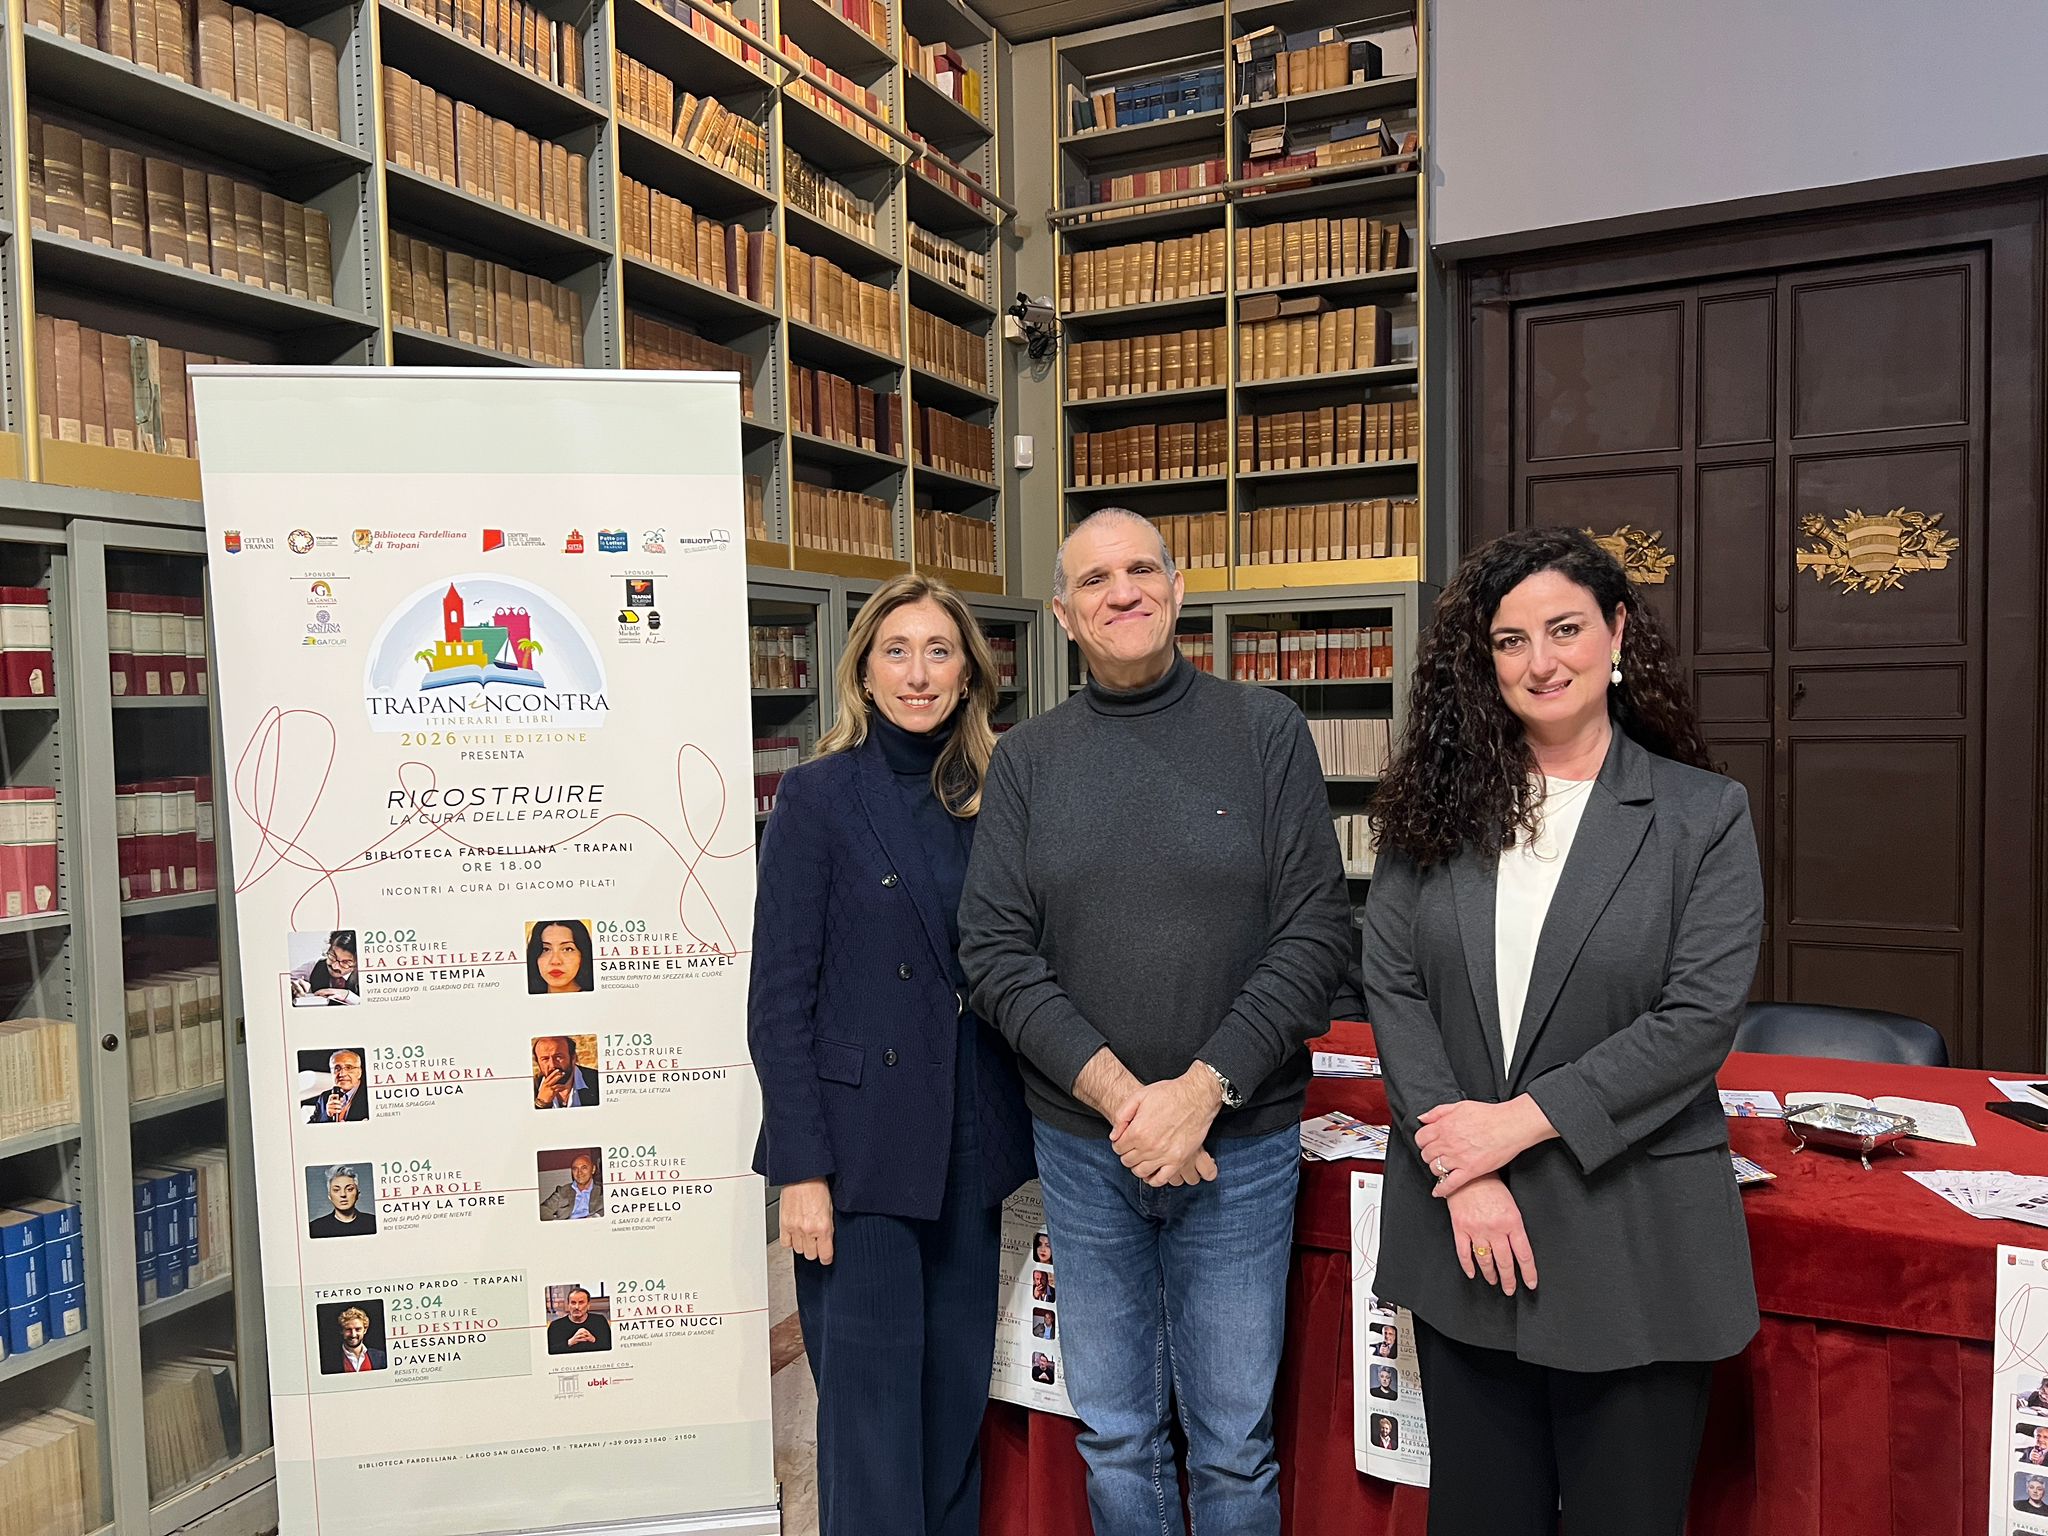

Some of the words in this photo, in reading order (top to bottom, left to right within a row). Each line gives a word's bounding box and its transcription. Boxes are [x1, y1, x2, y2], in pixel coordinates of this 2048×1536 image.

[374, 530, 416, 539] Biblioteca
[418, 530, 467, 538] Fardelliana
[374, 541, 382, 549] di
[387, 542, 420, 550] Trapani
[426, 716, 497, 726] ITINERARI
[505, 716, 512, 724] E
[518, 714, 553, 724] LIBRI
[400, 732, 457, 746] 2026
[463, 735, 495, 744] VIII
[504, 733, 587, 744] EDIZIONE
[461, 750, 525, 760] PRESENTA
[387, 784, 605, 808] RICOSTRUIRE
[390, 814, 412, 825] LA
[418, 812, 466, 824] CURA
[473, 810, 527, 822] DELLE
[532, 808, 600, 821] PAROLE
[365, 849, 452, 861] BIBLIOTECA
[459, 845, 557, 857] FARDELLIANA
[574, 842, 633, 852] TRAPANI
[462, 862, 492, 872] ORE
[500, 860, 542, 871] 18.00
[382, 885, 442, 896] INCONTRI
[447, 885, 455, 893] A
[460, 883, 492, 892] CURA
[498, 882, 510, 891] DI
[516, 880, 574, 890] GIACOMO
[580, 879, 616, 888] PILATI
[596, 920, 646, 933] 06.03
[364, 929, 416, 944] 20.02
[600, 932, 678, 942] RICOSTRUIRE
[364, 942, 448, 954] RICOSTRUIRE
[600, 946, 620, 956] LA
[630, 942, 721, 956] BELLEZZA
[366, 956, 387, 968] LA
[396, 950, 519, 966] GENTILEZZA
[600, 960, 660, 971] SABRINE
[666, 959, 682, 969] EL
[687, 956, 734, 968] MAYEL
[366, 970, 424, 984] SIMONE
[432, 968, 485, 981] TEMPIA
[702, 970, 723, 978] CUORE
[604, 1033, 653, 1047] 17.03
[373, 1045, 425, 1060] 13.03
[605, 1046, 683, 1057] RICOSTRUIRE
[373, 1057, 455, 1070] RICOSTRUIRE
[606, 1060, 625, 1070] LA
[635, 1059, 680, 1069] PACE
[374, 1074, 396, 1084] LA
[406, 1067, 495, 1082] MEMORIA
[606, 1073, 656, 1084] DAVIDE
[662, 1070, 726, 1082] RONDONI
[375, 1088, 420, 1100] LUCIO
[426, 1085, 464, 1096] LUCA
[406, 1100, 436, 1108] SPIAGGIA
[608, 1146, 657, 1160] 20.04
[380, 1159, 432, 1175] 10.04
[609, 1158, 687, 1169] RICOSTRUIRE
[381, 1171, 462, 1184] RICOSTRUIRE
[610, 1172, 626, 1182] IL
[635, 1170, 681, 1180] MITO
[382, 1187, 402, 1198] LE
[412, 1182, 483, 1196] PAROLE
[611, 1186, 667, 1198] ANGELO
[672, 1184, 713, 1195] PIERO
[382, 1200, 431, 1213] CATHY
[436, 1198, 454, 1209] LA
[458, 1196, 505, 1208] TORRE
[611, 1201, 682, 1214] CAPPELLO
[315, 1288, 362, 1299] TEATRO
[366, 1283, 414, 1295] TONINO
[419, 1279, 459, 1290] PARDO
[473, 1275, 524, 1286] TRAPANI
[617, 1278, 666, 1294] 29.04
[391, 1295, 443, 1311] 23.04
[616, 1292, 698, 1304] RICOSTRUIRE
[391, 1308, 478, 1323] RICOSTRUIRE
[617, 1304, 695, 1318] L'AMORE
[392, 1326, 408, 1337] IL
[418, 1318, 500, 1333] DESTINO
[619, 1318, 675, 1332] MATTEO
[680, 1317, 723, 1327] NUCCI
[687, 1329, 715, 1337] D'AMORE
[393, 1333, 487, 1350] ALESSANDRO
[394, 1352, 462, 1366] D'AVENIA
[588, 1378, 608, 1388] ubik
[358, 1460, 404, 1469] BIBLIOTECA
[406, 1455, 457, 1464] FARDELLIANA
